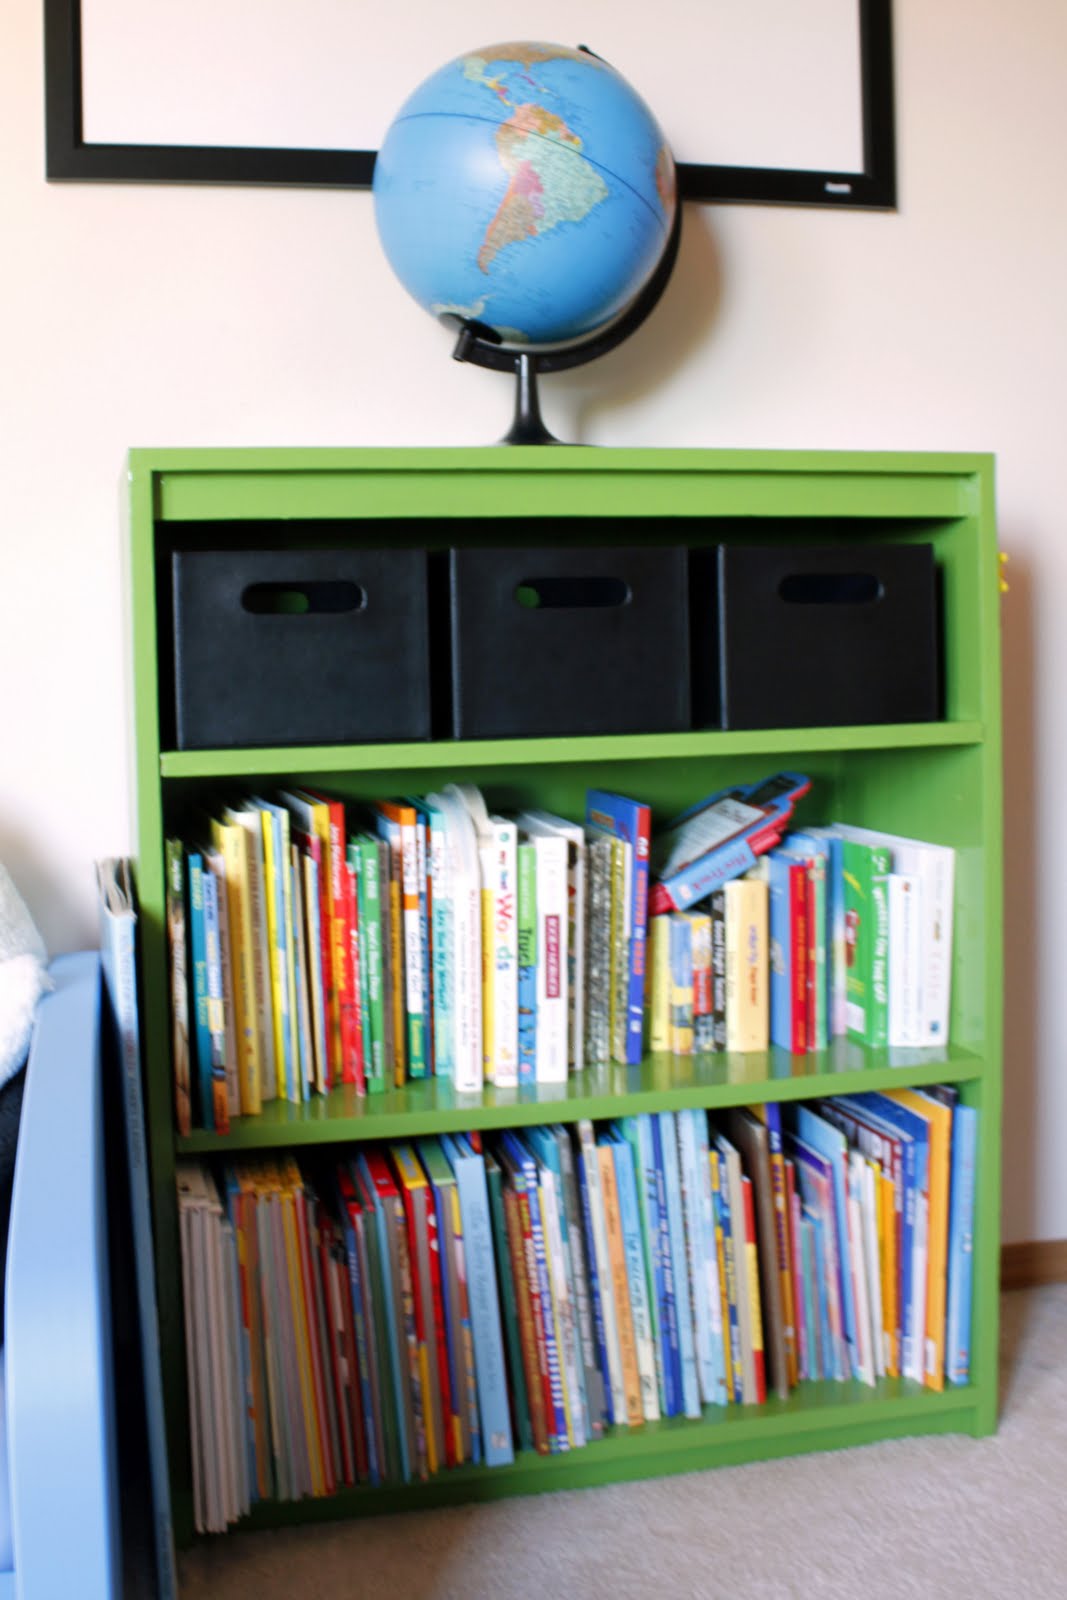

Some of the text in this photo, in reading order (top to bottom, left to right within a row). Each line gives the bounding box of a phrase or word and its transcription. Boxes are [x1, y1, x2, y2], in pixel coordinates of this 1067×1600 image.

[496, 894, 514, 970] Words
[518, 927, 533, 982] Trucks
[527, 1238, 541, 1294] ROBERTO
